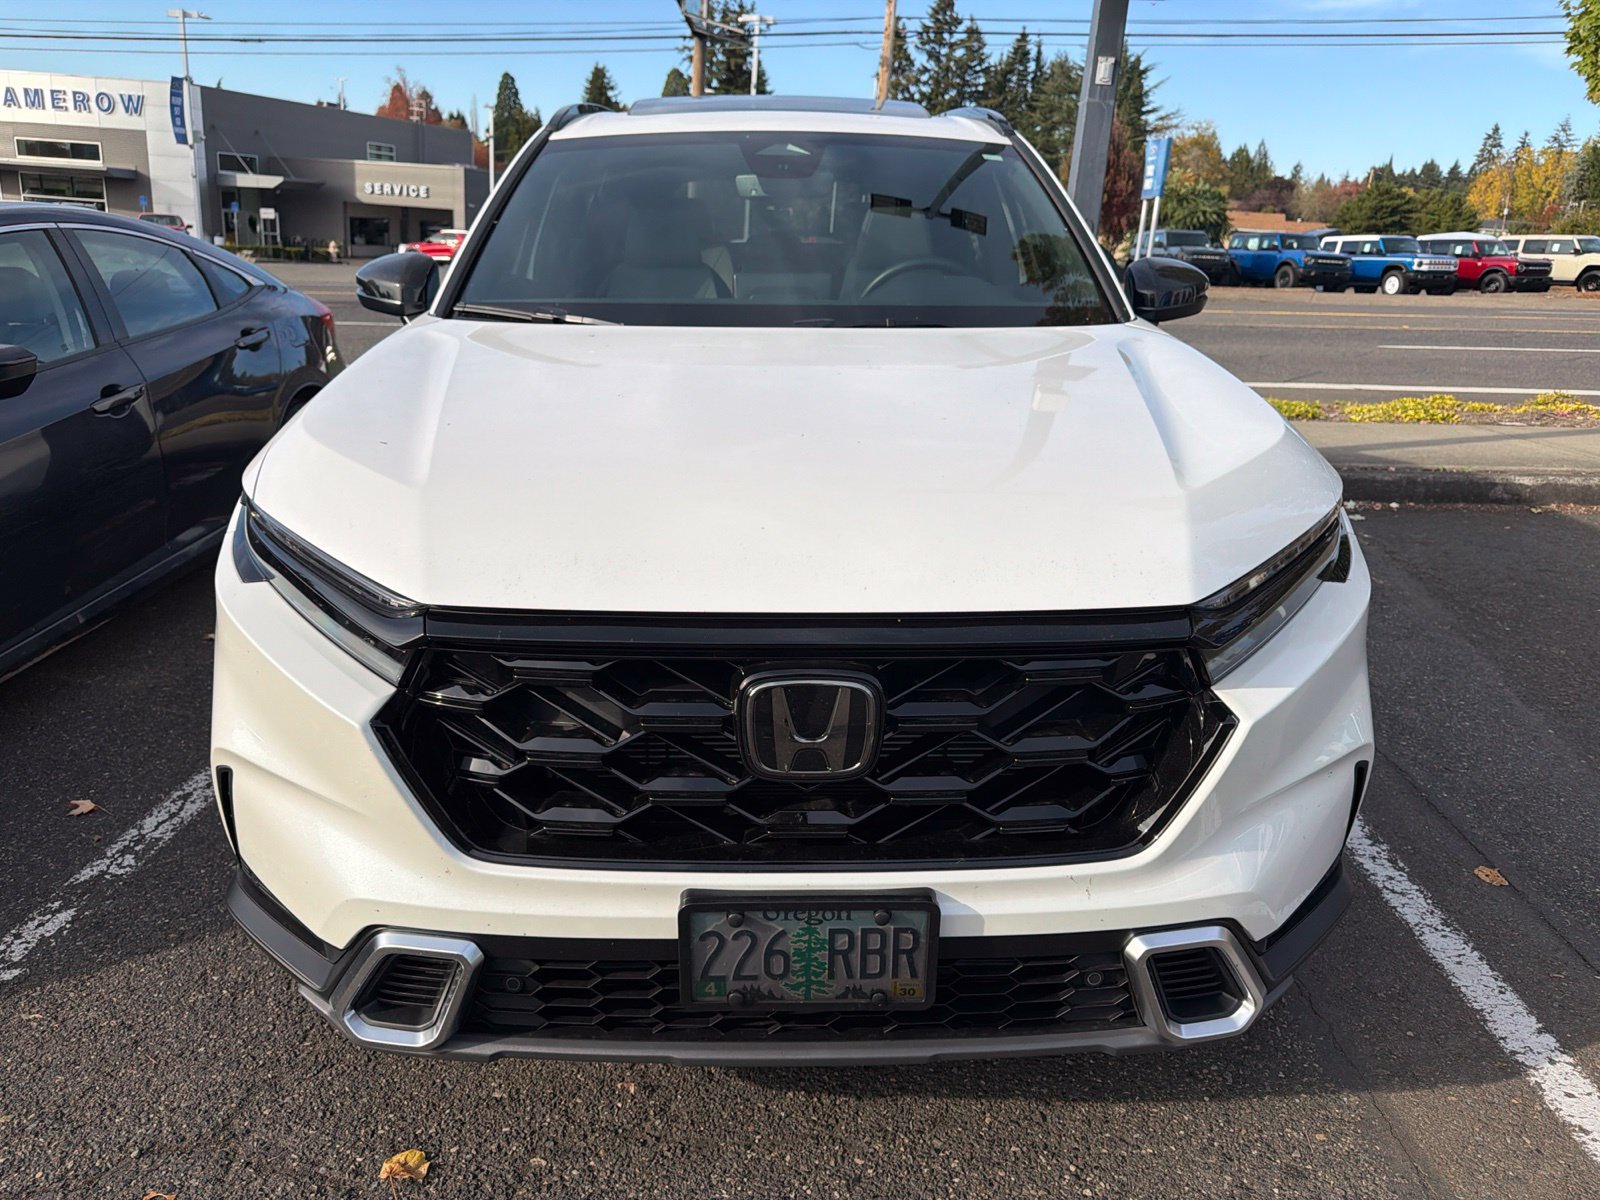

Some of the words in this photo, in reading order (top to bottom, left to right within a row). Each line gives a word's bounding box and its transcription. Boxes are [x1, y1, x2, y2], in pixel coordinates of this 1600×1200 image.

[3, 86, 145, 116] AMEROW
[364, 182, 430, 198] SERVICE
[763, 909, 852, 925] Oregon
[699, 929, 790, 981] 226
[827, 927, 920, 980] RBR
[704, 981, 718, 995] 4
[899, 987, 916, 997] 30
